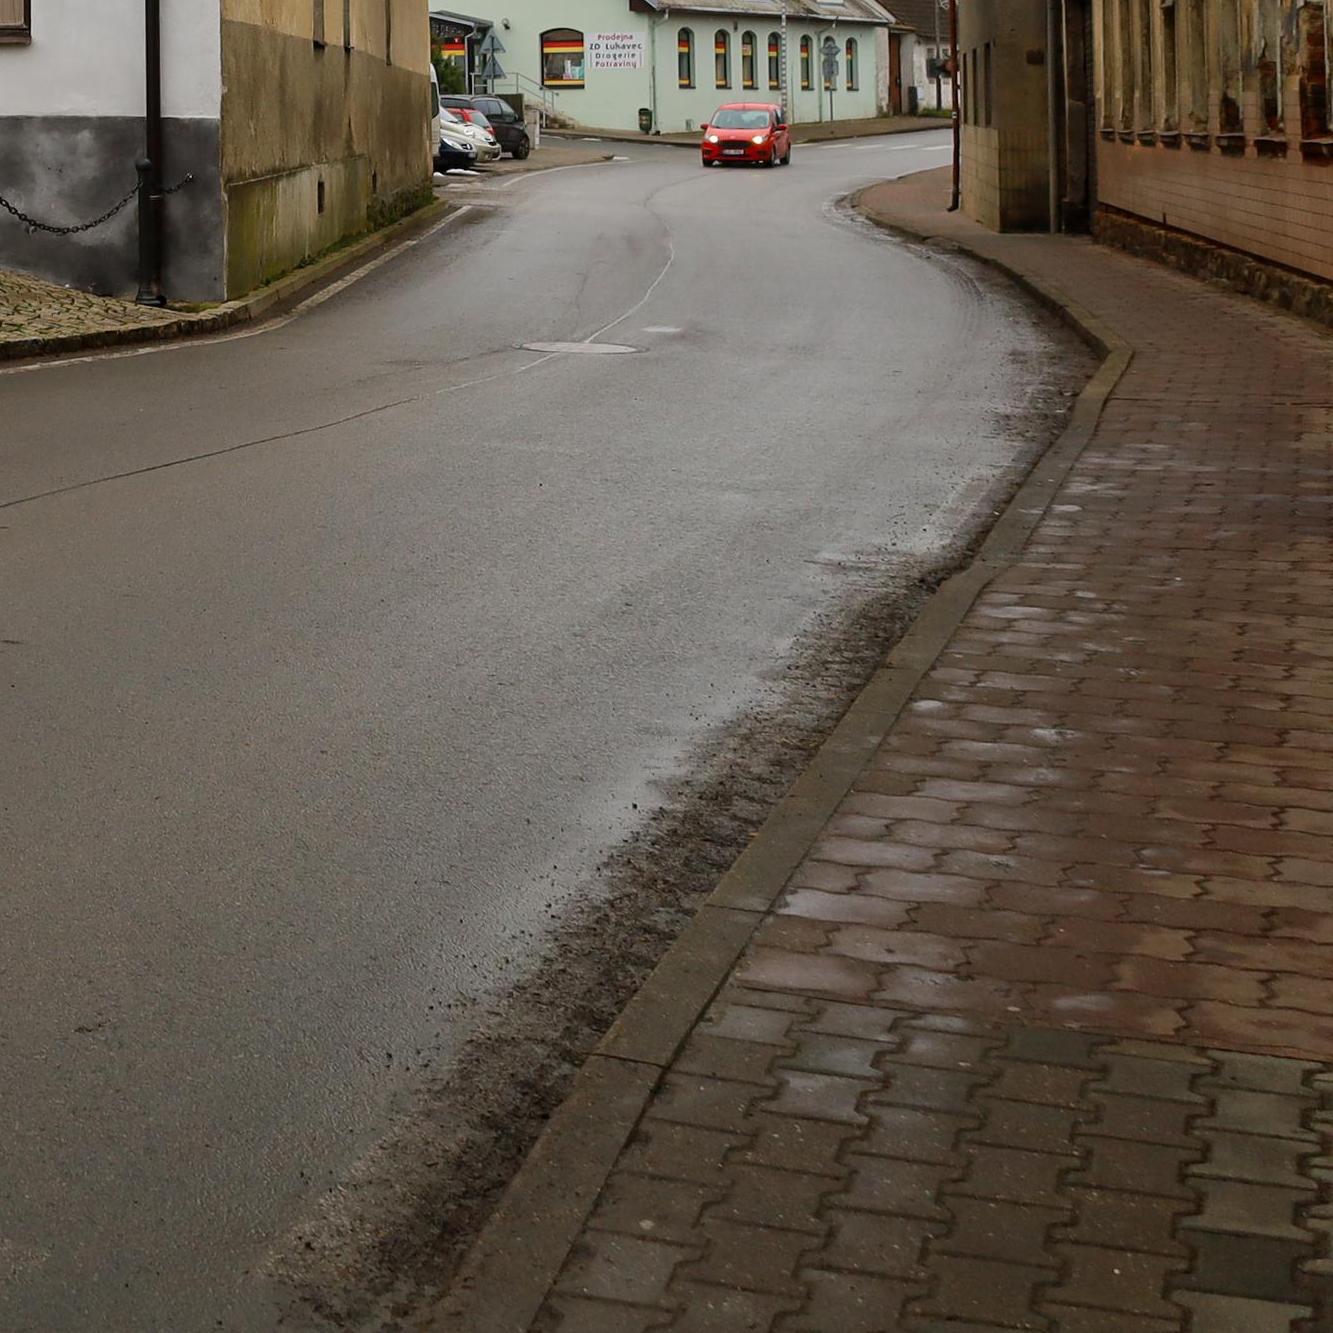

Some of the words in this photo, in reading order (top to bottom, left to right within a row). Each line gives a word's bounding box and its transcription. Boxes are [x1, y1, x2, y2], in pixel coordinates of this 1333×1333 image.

[597, 33, 633, 41] Prodejna
[595, 52, 636, 60] Drogerie
[595, 61, 636, 69] Potraviny
